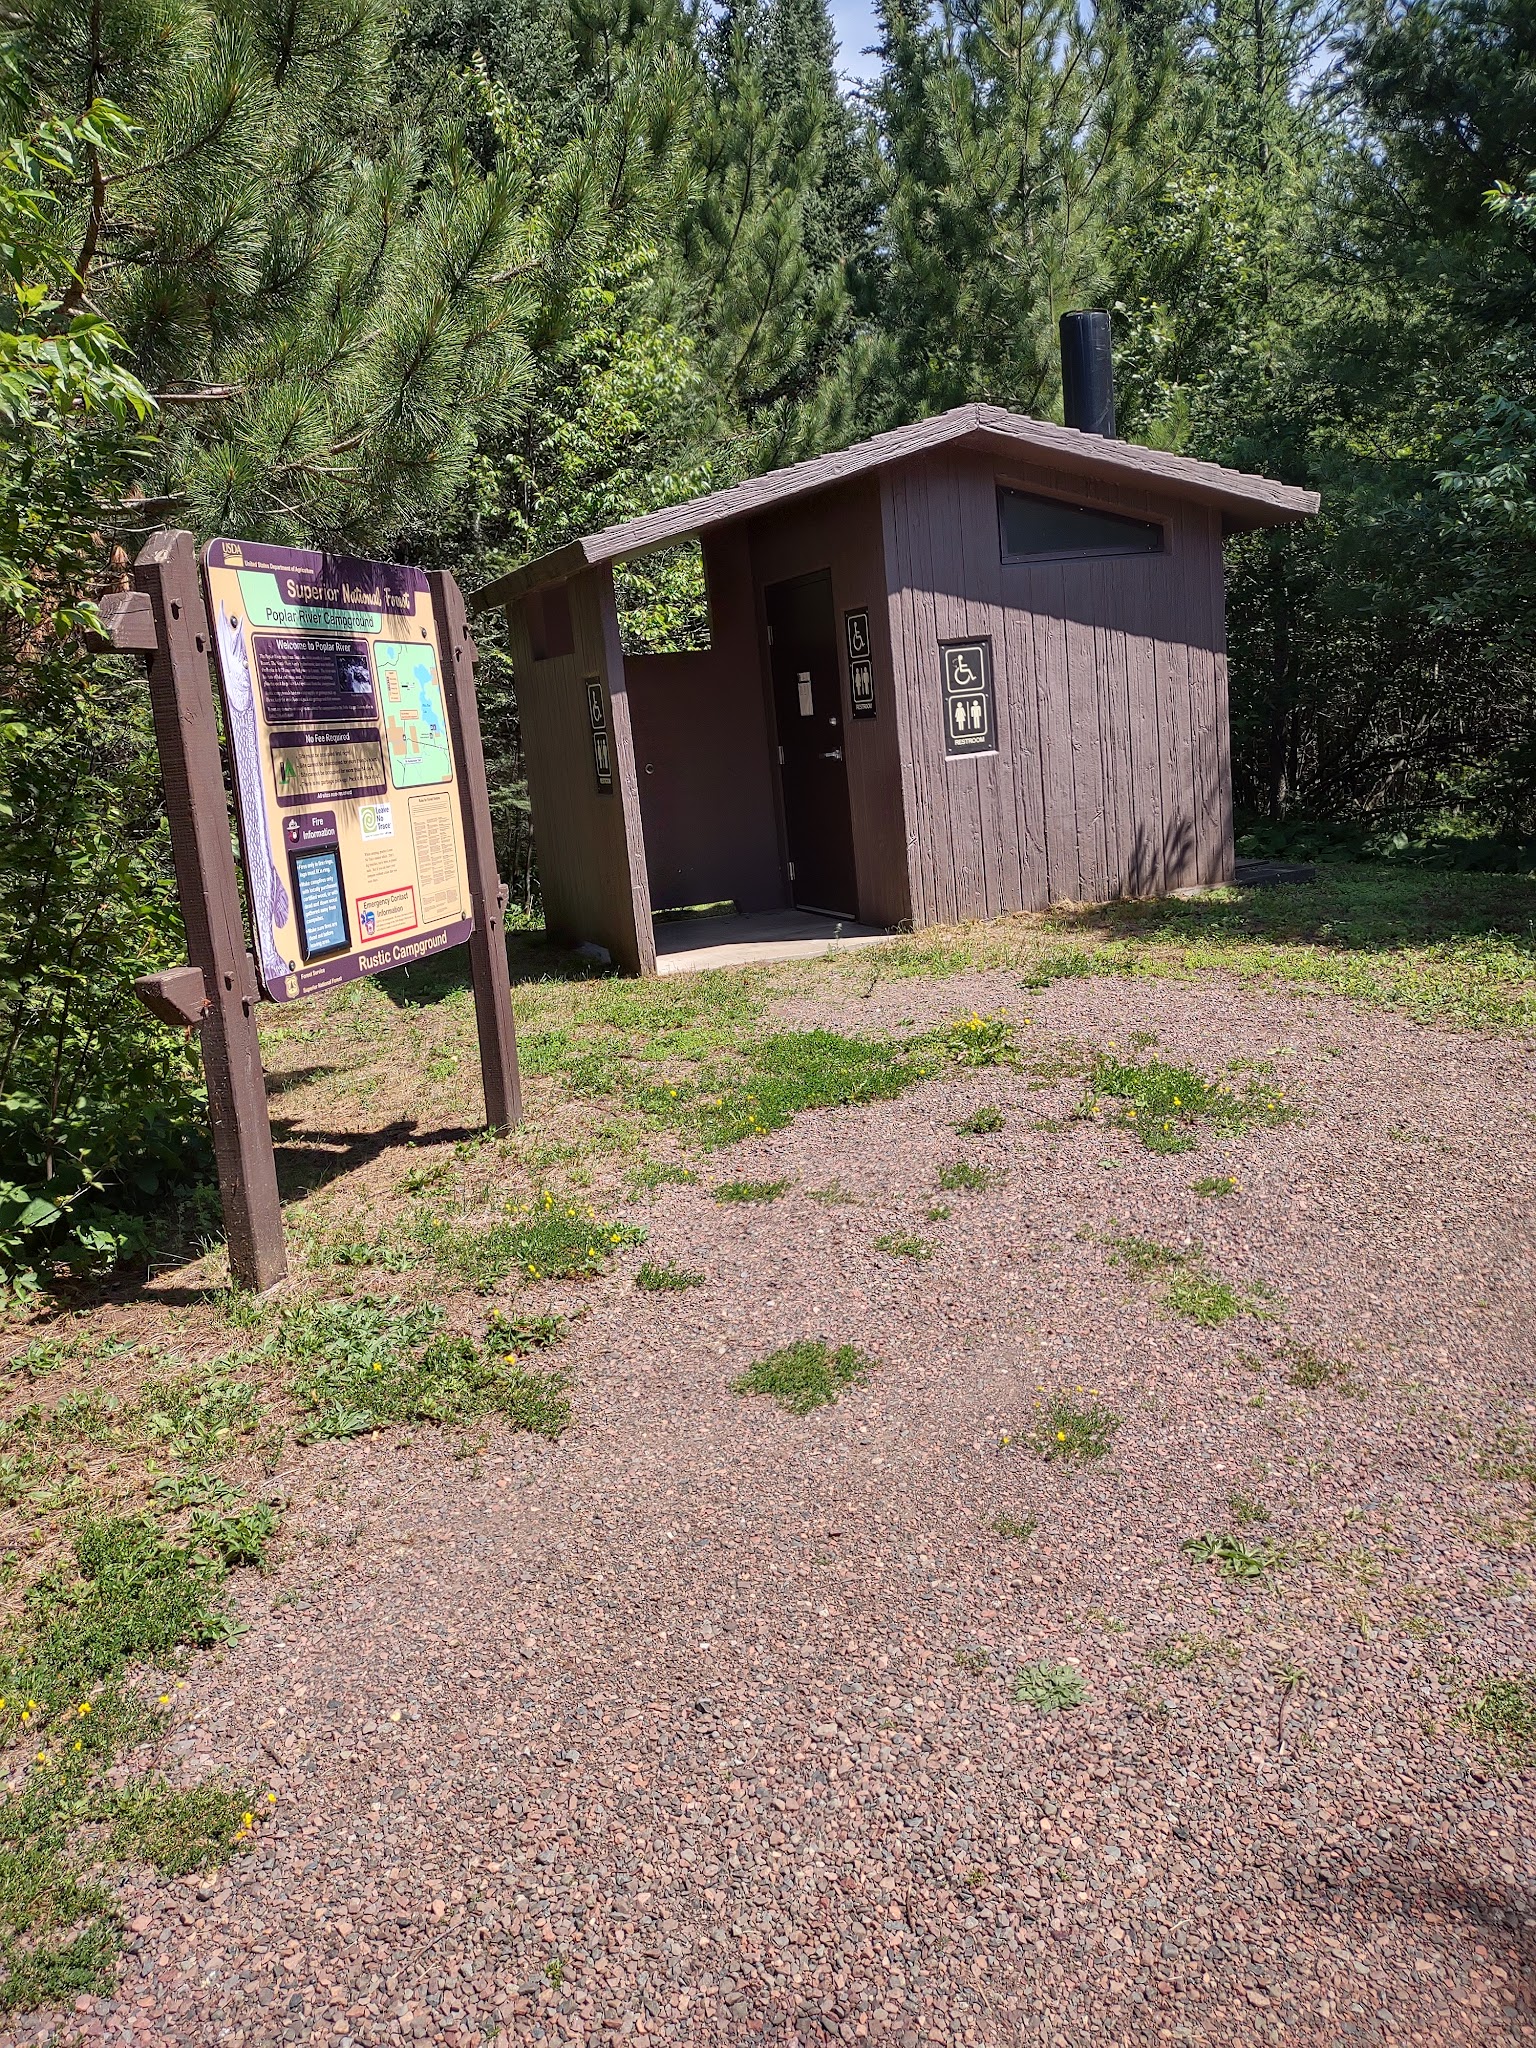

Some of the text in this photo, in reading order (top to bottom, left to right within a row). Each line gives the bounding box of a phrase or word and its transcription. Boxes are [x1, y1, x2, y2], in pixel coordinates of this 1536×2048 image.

[222, 542, 242, 554] USDA
[296, 566, 314, 574] Agriculture
[286, 579, 410, 610] Superior National Forest
[266, 608, 374, 628] Poplar River Campground
[276, 639, 350, 653] Welcome to Poplar River
[306, 732, 350, 743] No Fee Required
[954, 736, 985, 746] RESTROOM
[312, 818, 324, 826] Fire
[302, 828, 335, 840] Information
[364, 896, 390, 909] Emergency
[391, 892, 408, 903] Contact
[377, 905, 403, 917] Information
[358, 930, 448, 972] Rustic Campground
[313, 968, 325, 976] Service
[303, 984, 318, 993] Superior
